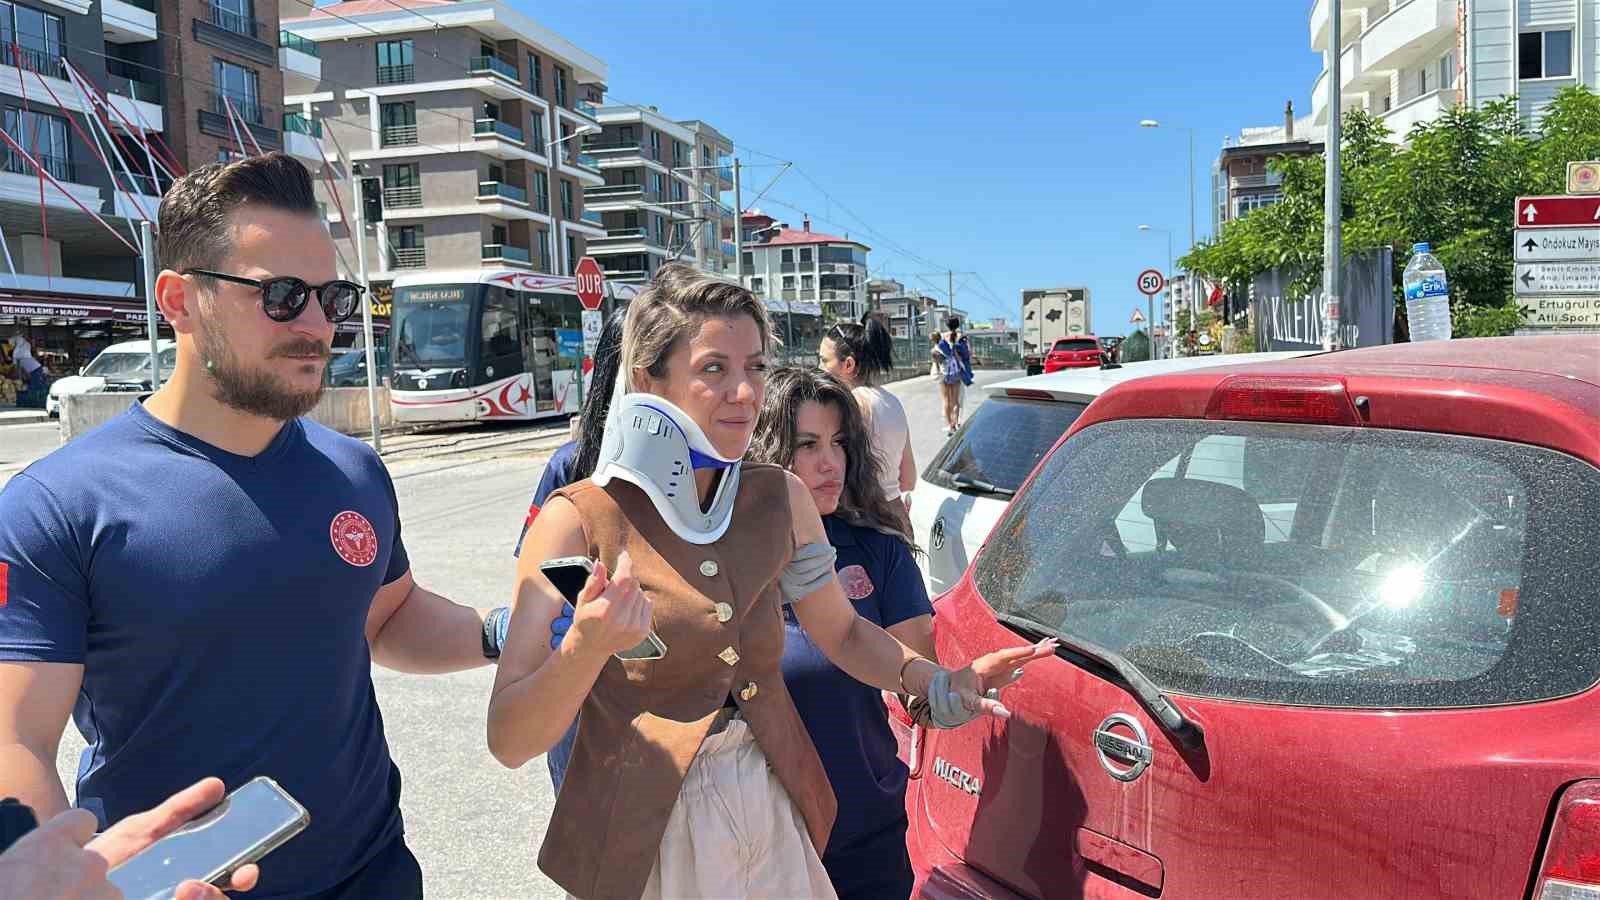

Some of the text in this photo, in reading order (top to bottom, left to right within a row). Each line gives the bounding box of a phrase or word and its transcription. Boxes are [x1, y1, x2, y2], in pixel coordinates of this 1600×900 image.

[1542, 236, 1577, 249] Ondokuz
[577, 273, 602, 294] DUR
[1143, 276, 1159, 289] 50
[1559, 312, 1591, 324] Spor
[932, 756, 983, 797] MICRA
